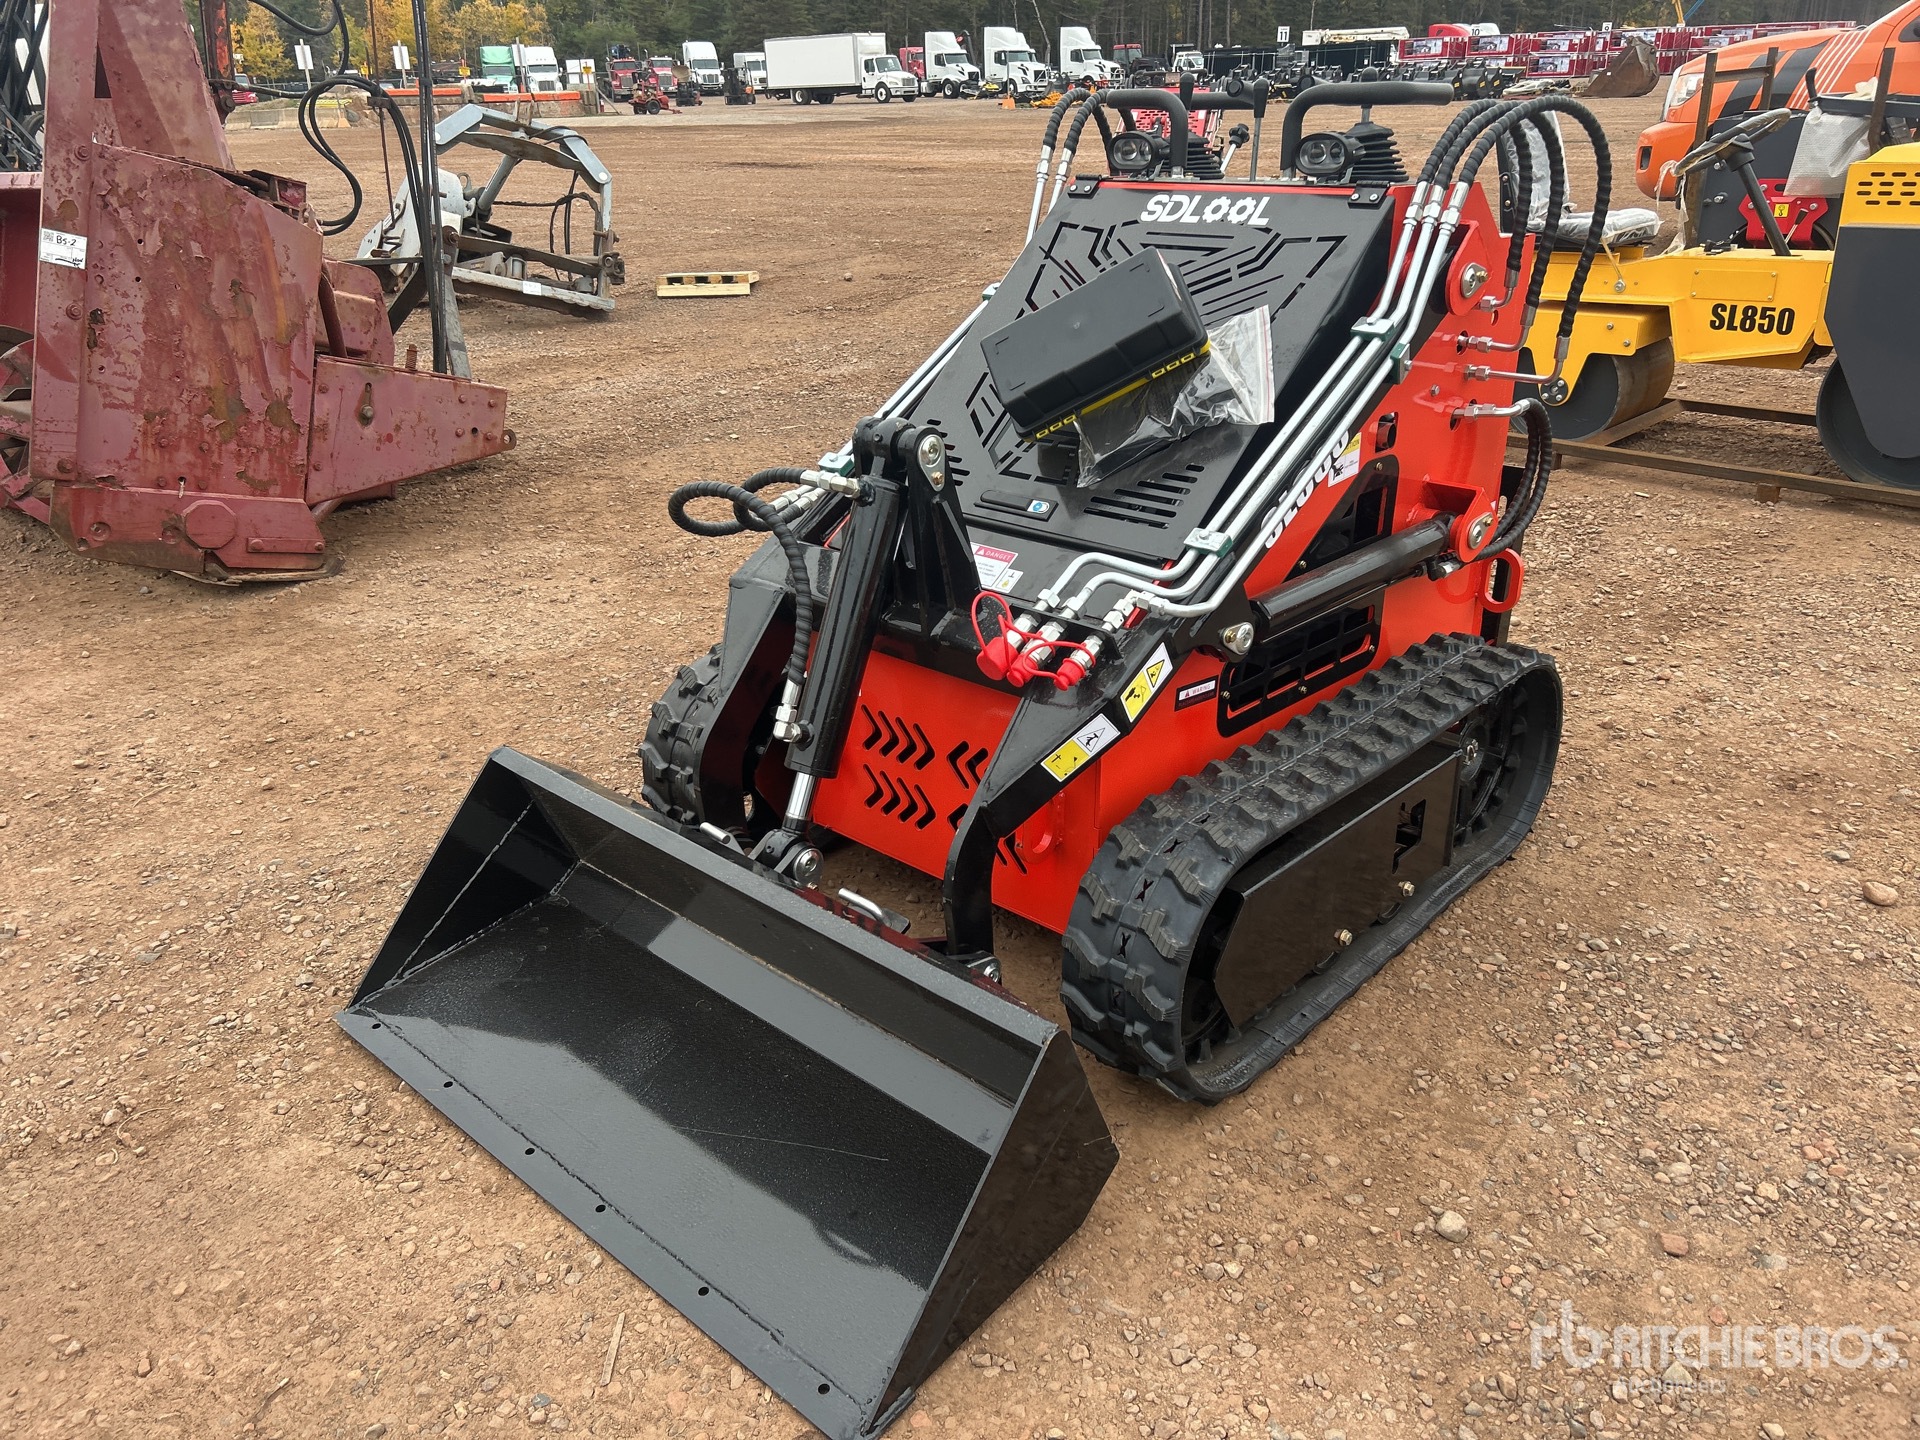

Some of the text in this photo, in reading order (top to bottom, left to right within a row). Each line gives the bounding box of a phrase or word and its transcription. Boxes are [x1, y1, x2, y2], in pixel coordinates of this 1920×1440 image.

[1280, 31, 1288, 41] 11
[1471, 28, 1480, 36] 10
[1140, 194, 1270, 226] SDLOOL
[1709, 303, 1796, 335] SL850
